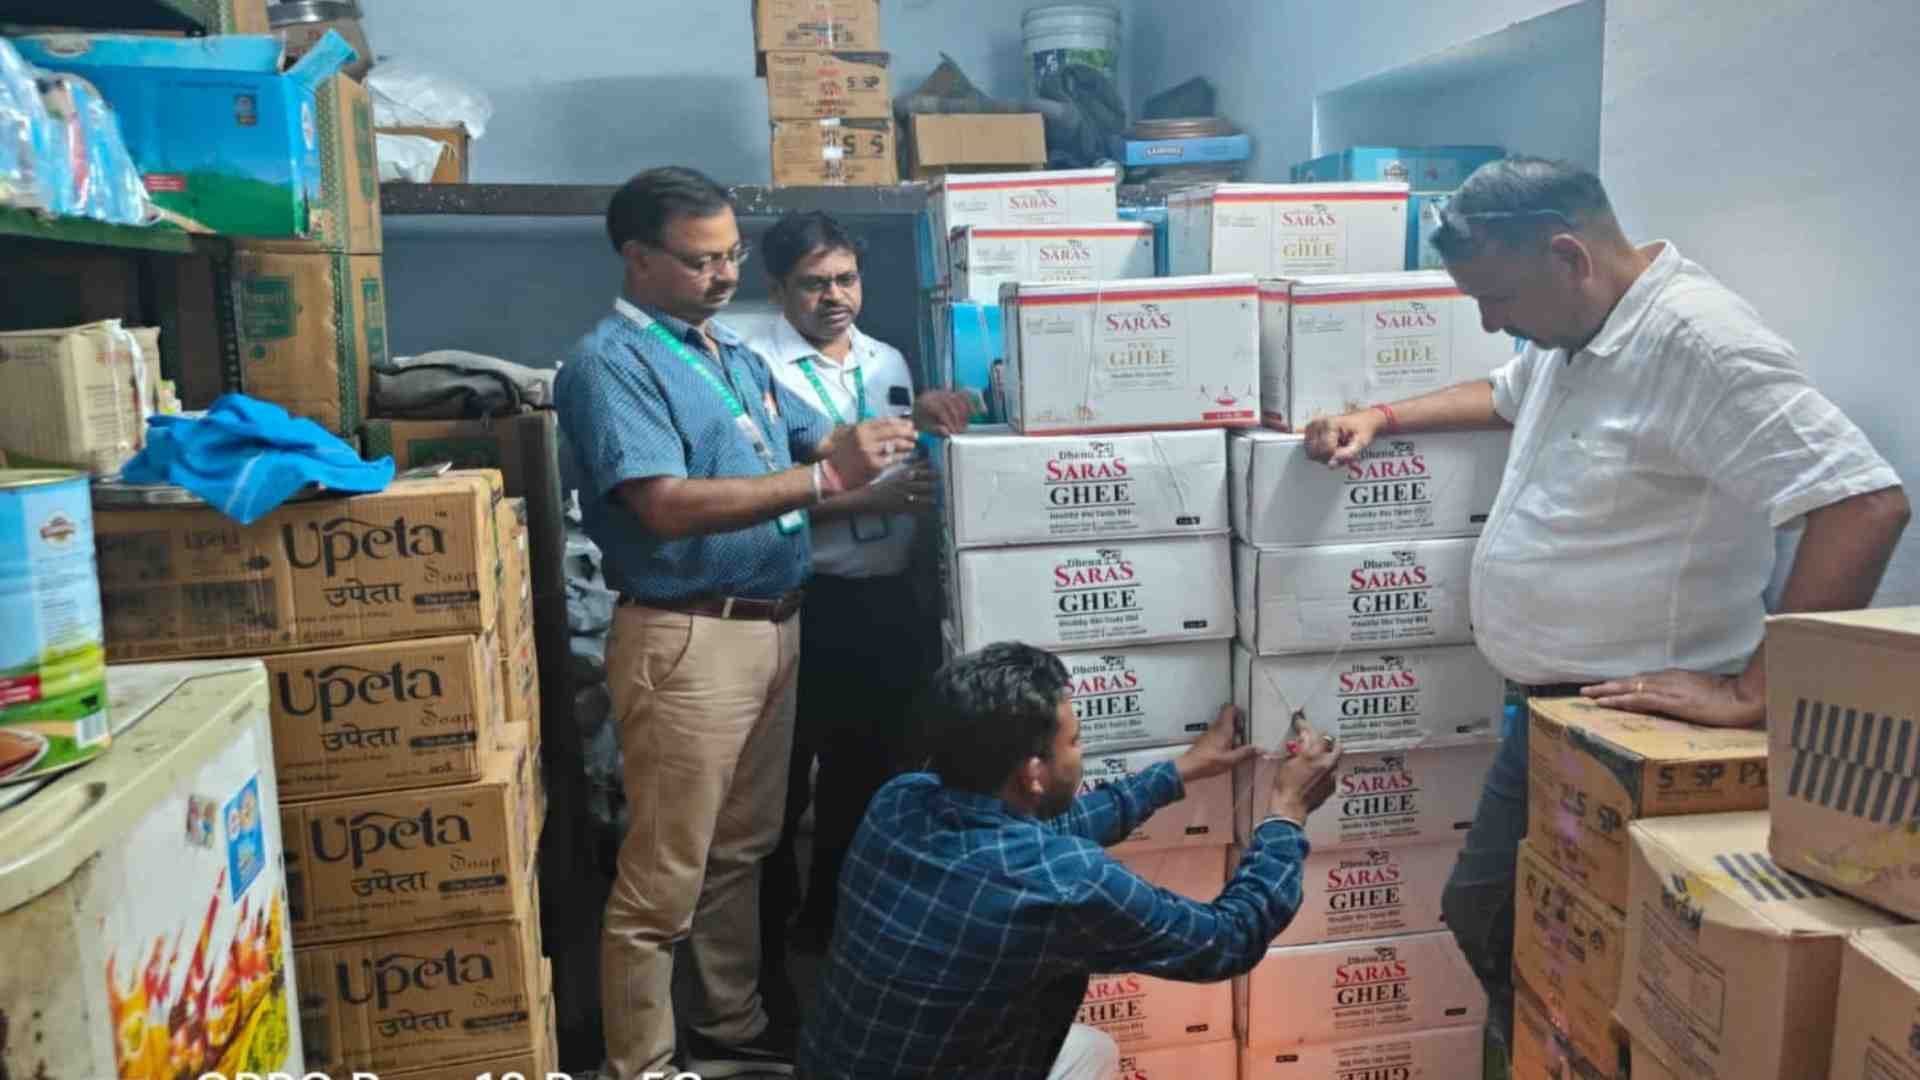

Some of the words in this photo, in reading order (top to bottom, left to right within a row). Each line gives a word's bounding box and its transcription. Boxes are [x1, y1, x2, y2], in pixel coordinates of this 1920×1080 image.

[1008, 195, 1058, 209] SARAS
[1281, 212, 1337, 227] SARAS
[1039, 247, 1091, 262] SARAS
[1106, 313, 1172, 333] SARAS
[1375, 311, 1438, 330] SARAS
[1046, 457, 1128, 481] SARAS
[1348, 455, 1427, 481] SARAS
[1049, 483, 1129, 505] GHEE
[1349, 482, 1427, 505] GHEE
[282, 515, 447, 577] Upeta
[1053, 561, 1135, 587] SARAS
[1350, 565, 1428, 591] SARAS
[321, 577, 404, 606] उपेता
[1057, 589, 1138, 613] GHEE
[1352, 591, 1429, 614] GHEE
[276, 663, 443, 722] Upeta
[1339, 669, 1417, 692] SARAS
[1341, 694, 1417, 717] GHEE
[320, 724, 401, 752] उपेता
[1342, 772, 1414, 794] SARAS
[1343, 794, 1416, 818] GHEE
[310, 806, 473, 869] Upeta
[350, 869, 432, 898] उपेता
[1327, 864, 1401, 889] SARAS
[1329, 887, 1401, 911] GHEE
[336, 947, 495, 1009] Upeta
[1335, 960, 1408, 985] SARAS
[1086, 977, 1141, 999] ARAS
[1336, 982, 1409, 1006] GHEE
[376, 1009, 454, 1038] उपेता
